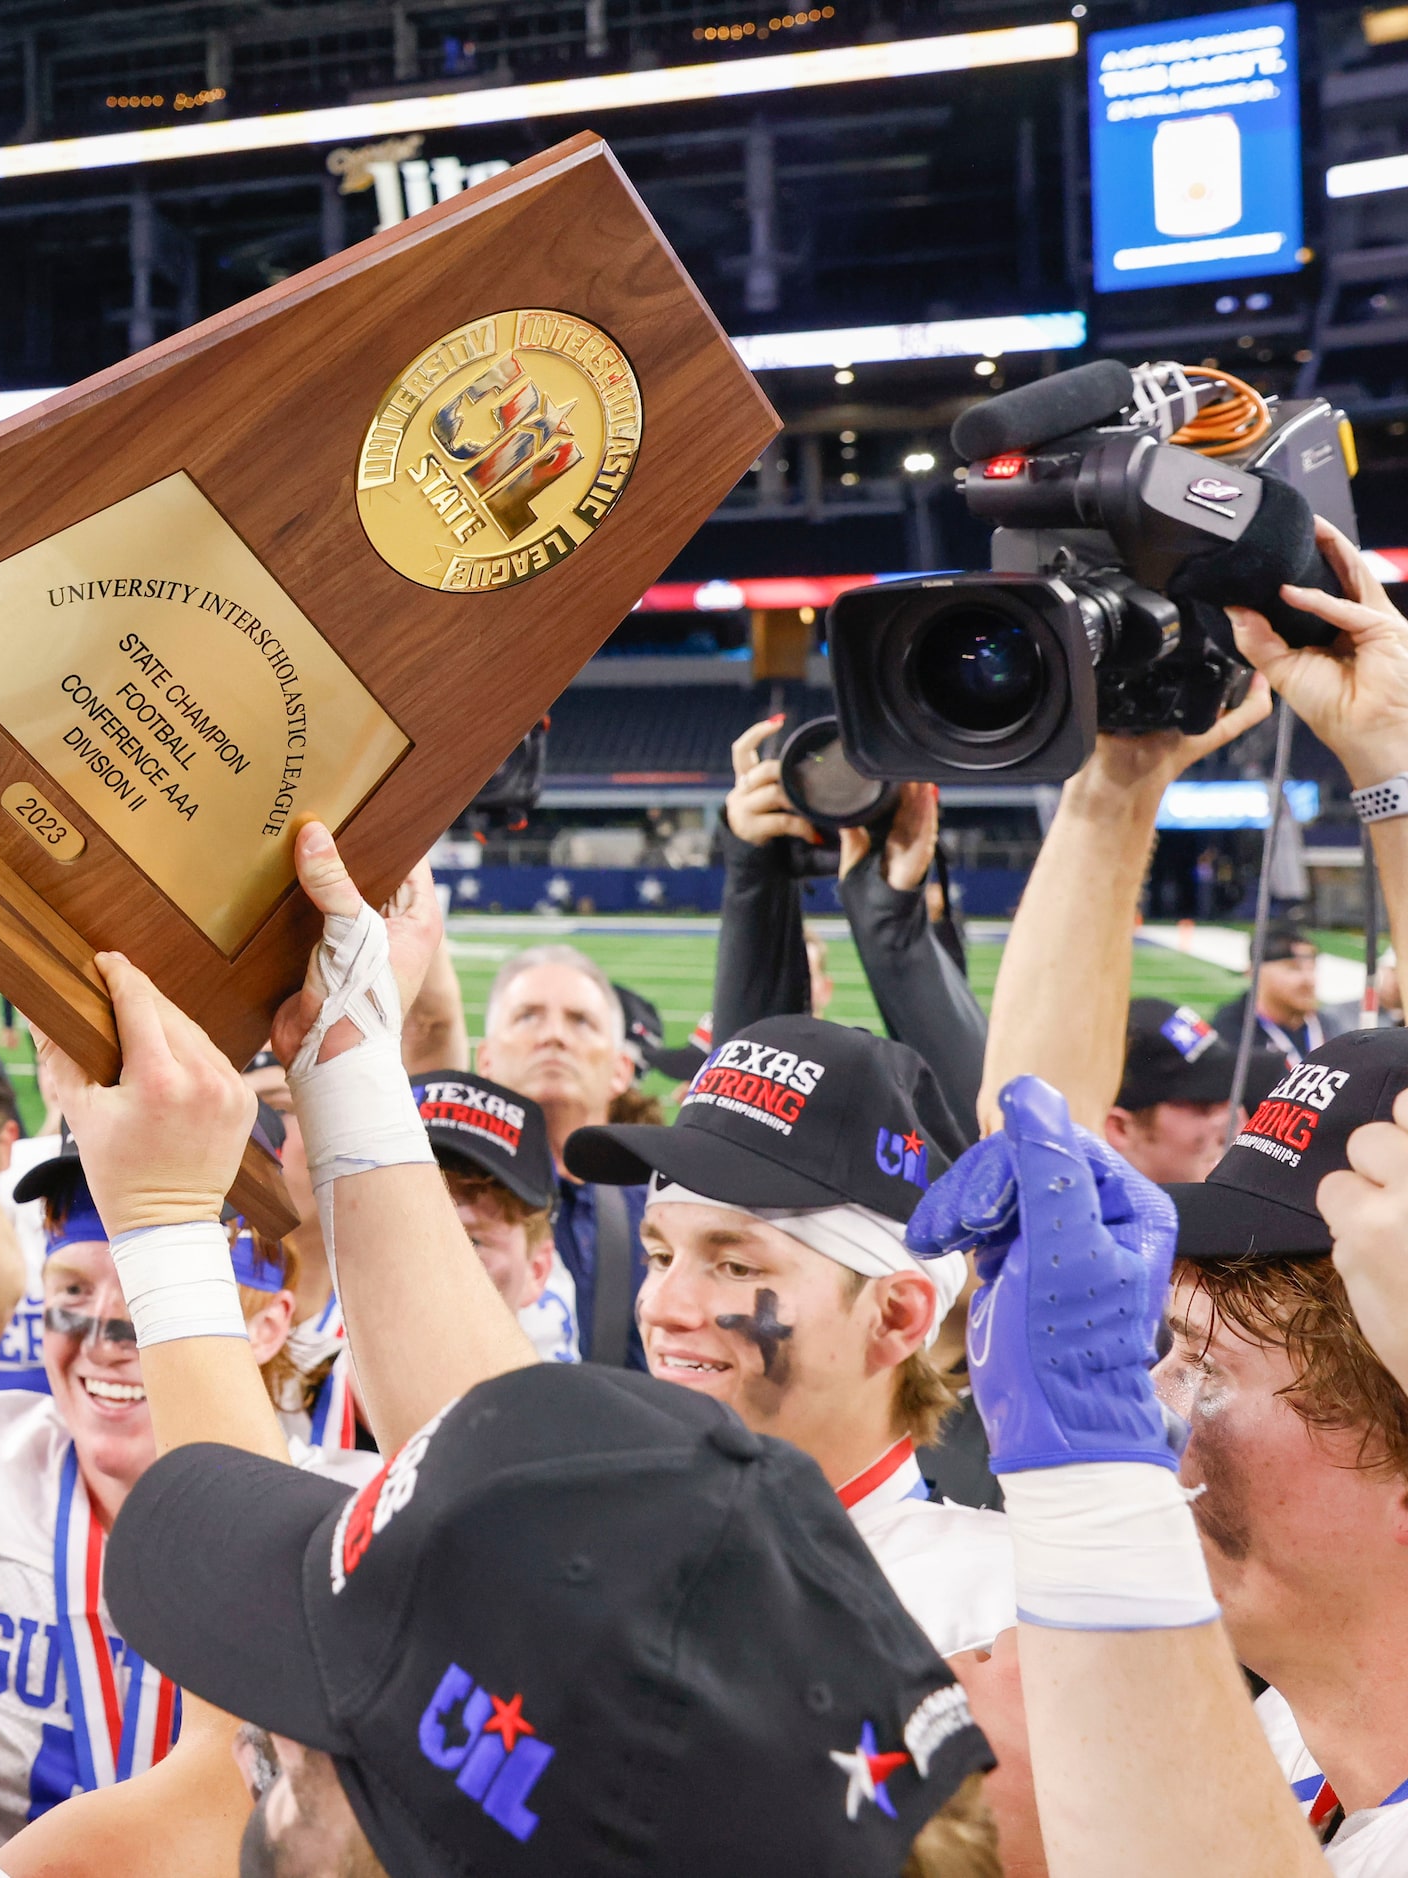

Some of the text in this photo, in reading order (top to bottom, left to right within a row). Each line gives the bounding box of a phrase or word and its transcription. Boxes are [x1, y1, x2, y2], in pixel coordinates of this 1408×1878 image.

[362, 325, 494, 481] UNIVERSITY
[520, 314, 639, 522] INTERSCHOLASTIC
[407, 448, 487, 545] STATE
[449, 533, 569, 588] LEAGUE
[46, 578, 307, 838] UNIVERSITY INTERSCHOLASTIC LEAGUE
[60, 673, 200, 822] CONFERENCE AAA
[115, 681, 199, 771] FOOTBALL
[118, 632, 251, 775] STATE CHAMPION
[62, 726, 148, 812] DIVISION II
[15, 796, 68, 846] 2023
[424, 1081, 526, 1131] TEXAS
[694, 1066, 807, 1124] STRONG
[711, 1039, 826, 1096] TEXAS
